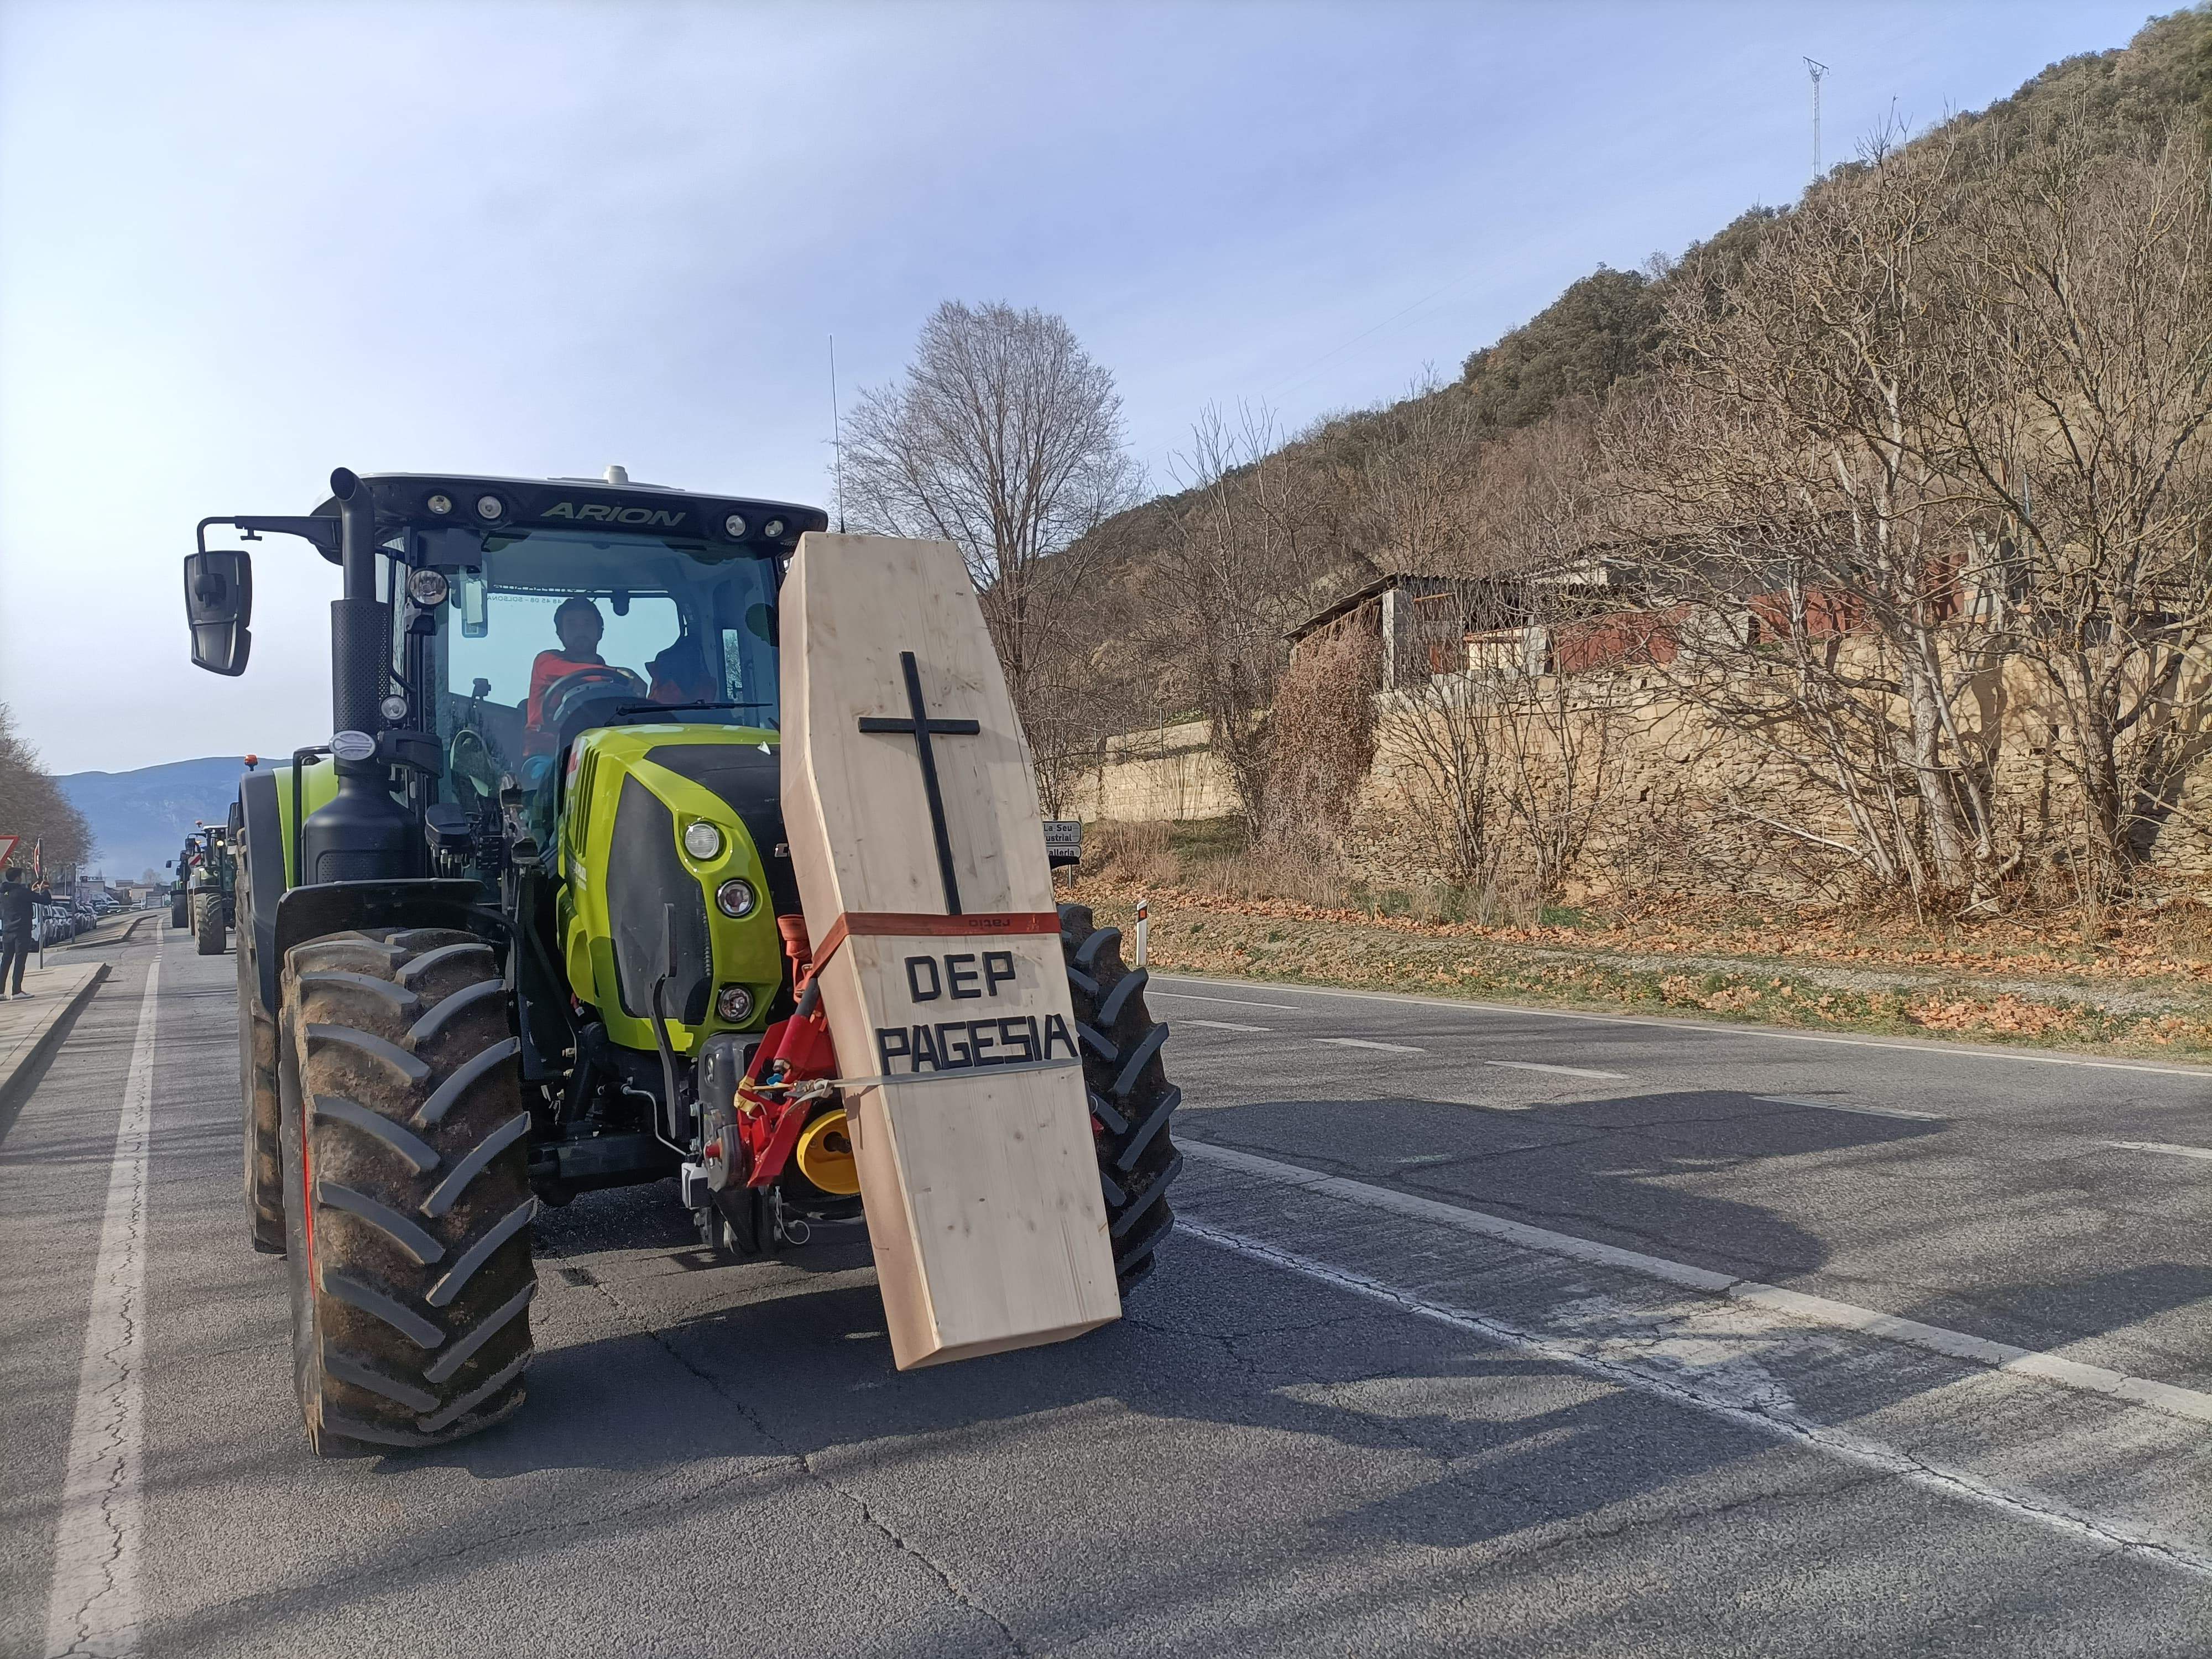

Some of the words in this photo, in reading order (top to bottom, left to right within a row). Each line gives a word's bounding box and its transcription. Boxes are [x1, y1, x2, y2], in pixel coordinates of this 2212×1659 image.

[540, 502, 686, 526] ARION
[904, 951, 1016, 1003] DEP
[875, 1013, 1079, 1076] PAGESIA
